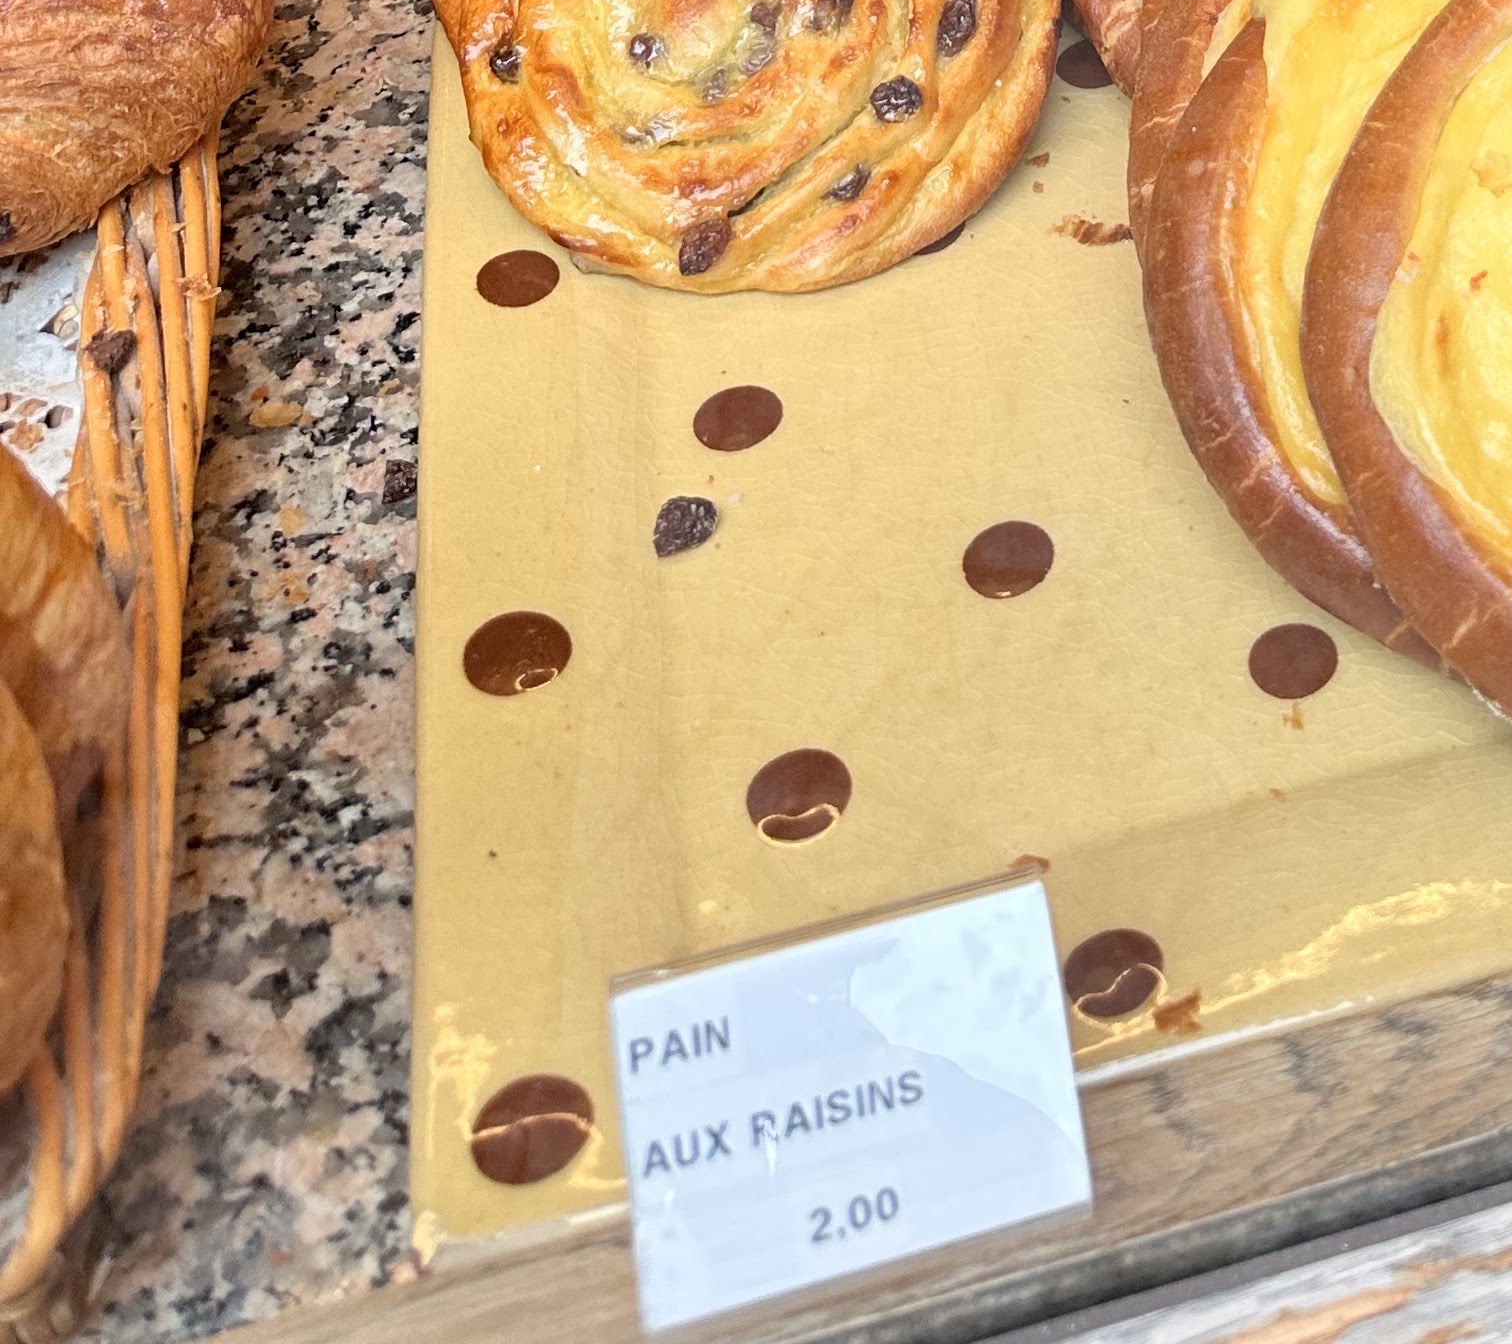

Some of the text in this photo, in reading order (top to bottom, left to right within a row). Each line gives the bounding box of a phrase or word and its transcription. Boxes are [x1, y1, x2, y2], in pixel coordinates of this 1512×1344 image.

[628, 1015, 731, 1075] PAIN
[642, 1070, 926, 1179] AUX RAISINS
[809, 1185, 900, 1245] 2,00
